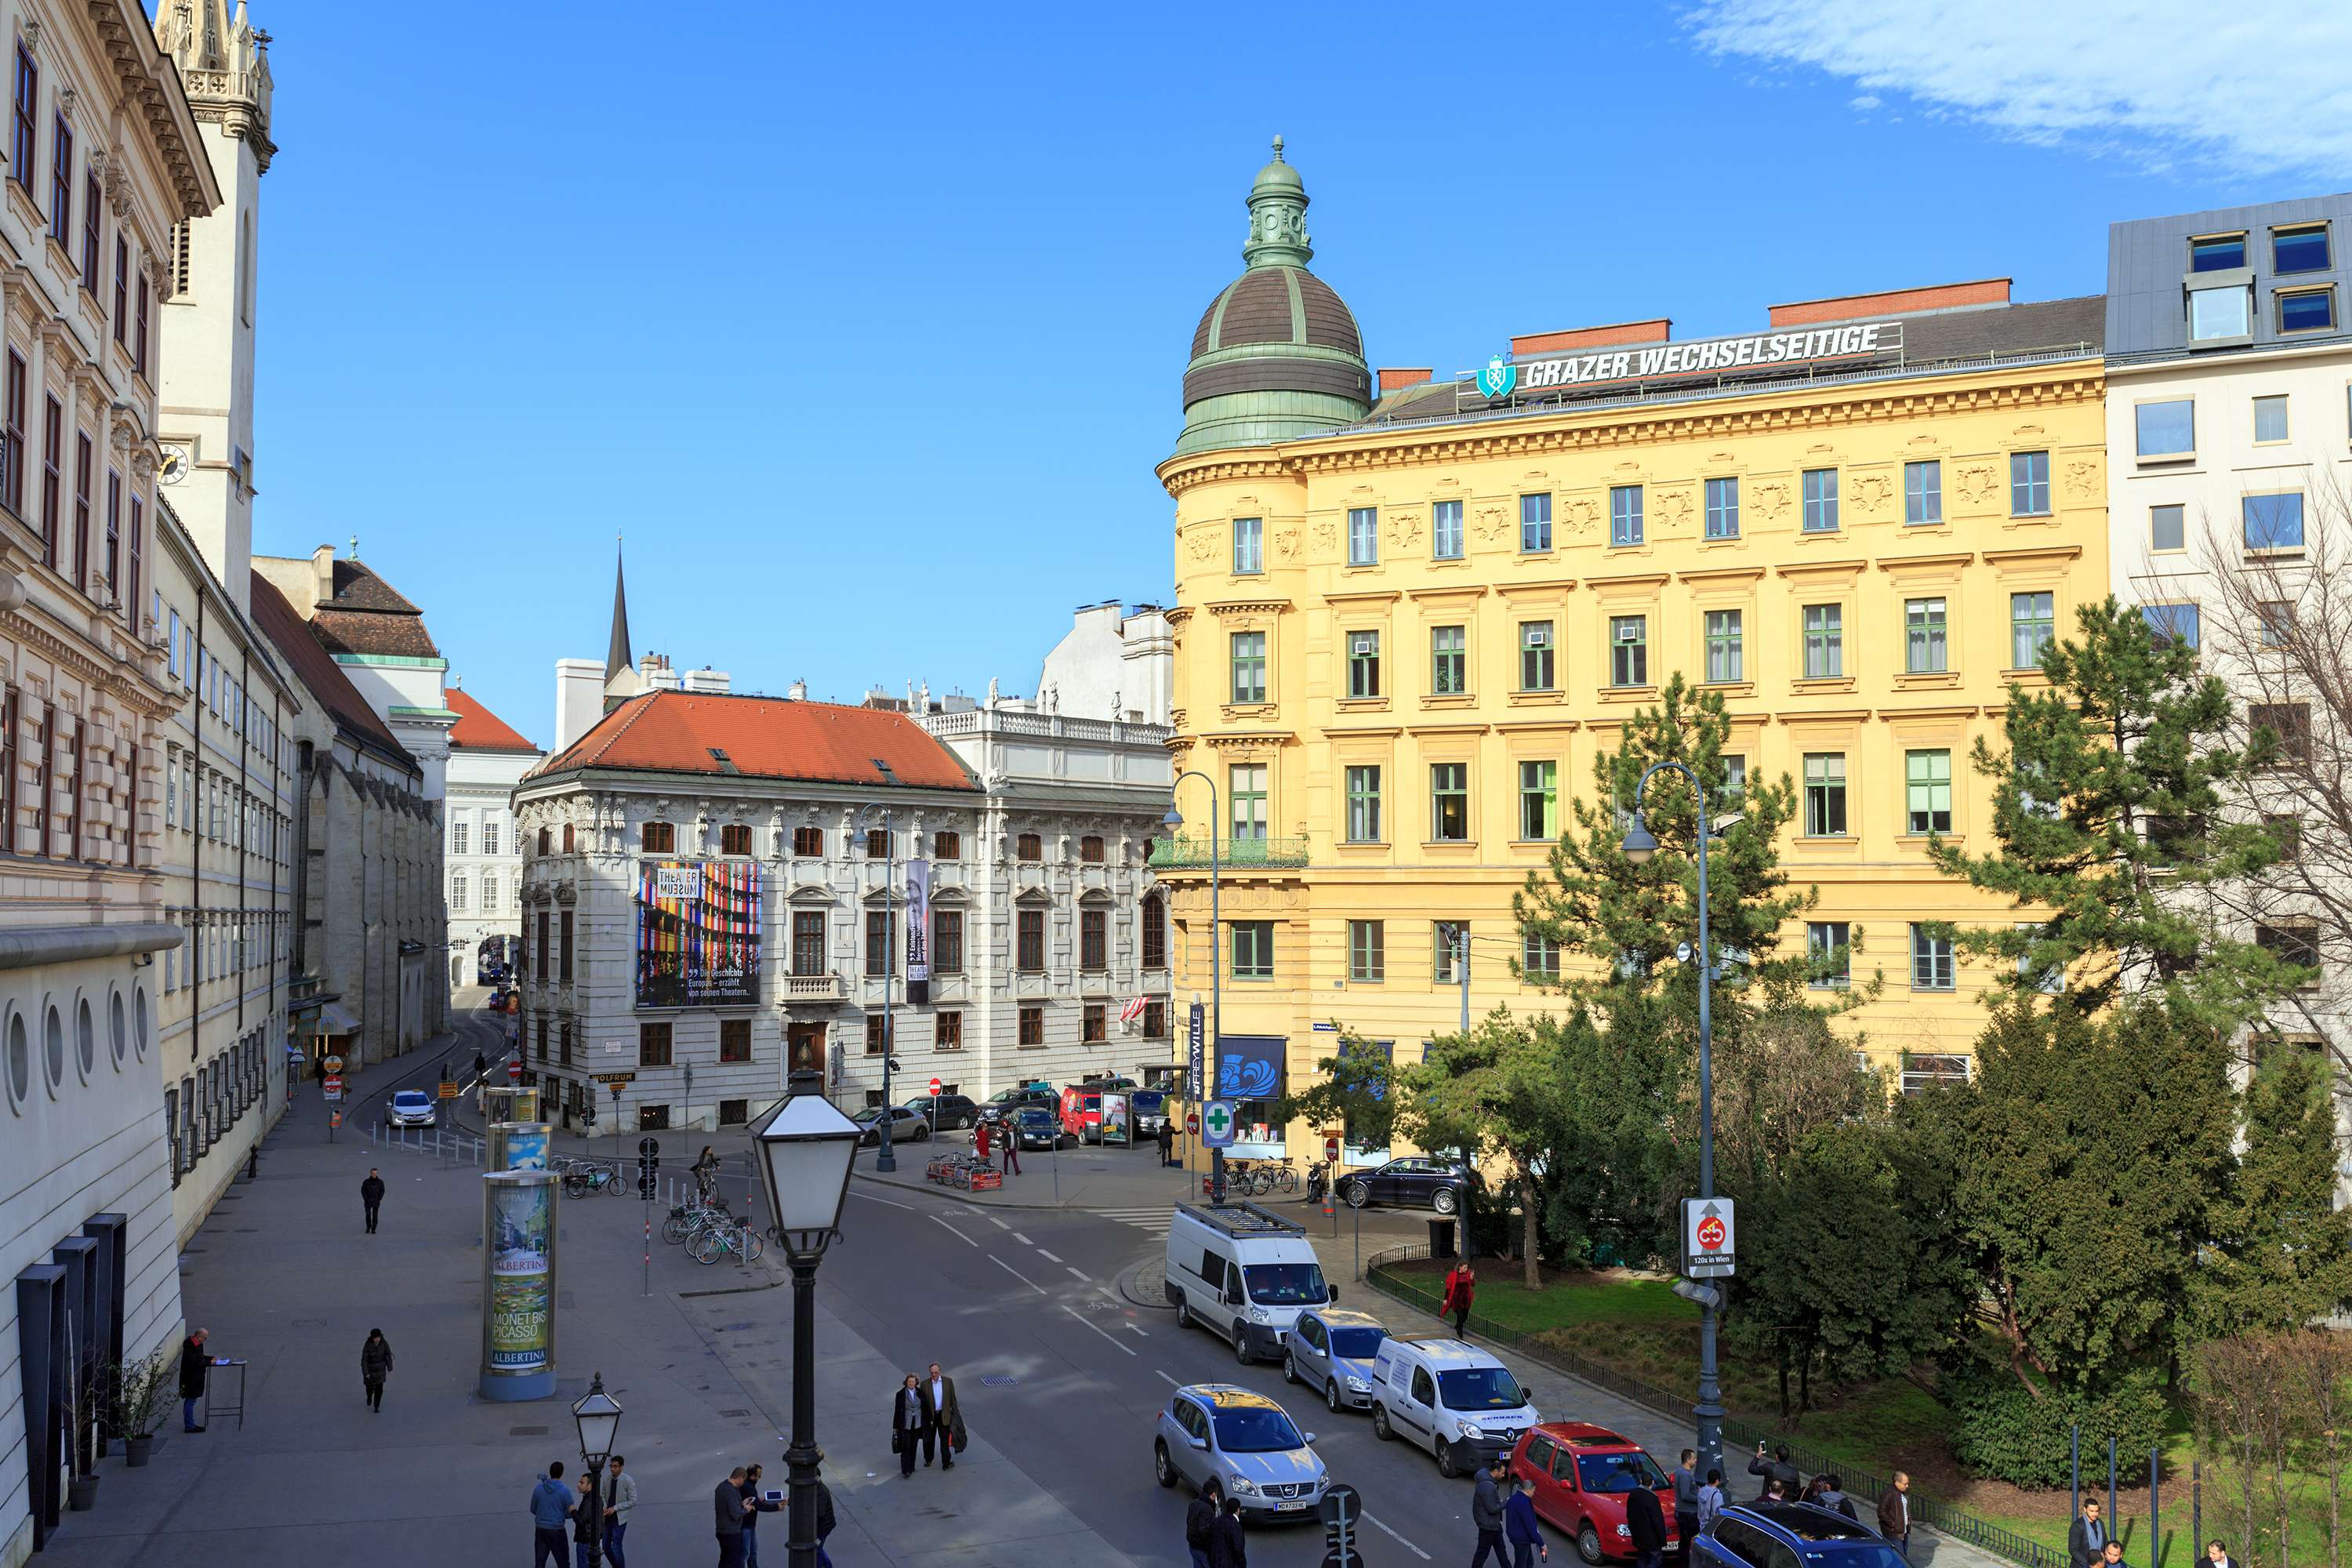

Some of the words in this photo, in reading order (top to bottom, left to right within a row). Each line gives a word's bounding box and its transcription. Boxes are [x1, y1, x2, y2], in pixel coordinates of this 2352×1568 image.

[1526, 353, 1630, 388] GRAZER
[1639, 325, 1881, 375] WECHSELSEITIGE
[659, 871, 697, 883] THEAER
[700, 969, 709, 978] Die
[711, 968, 743, 978] Geschichte
[689, 978, 712, 989] Europas
[719, 978, 739, 986] erzählt
[495, 1259, 546, 1270] ALBERTINA
[494, 1312, 531, 1326] MONET
[532, 1310, 546, 1324] BIS
[494, 1324, 538, 1338] PICASSO
[494, 1351, 545, 1362] ALBERTINA
